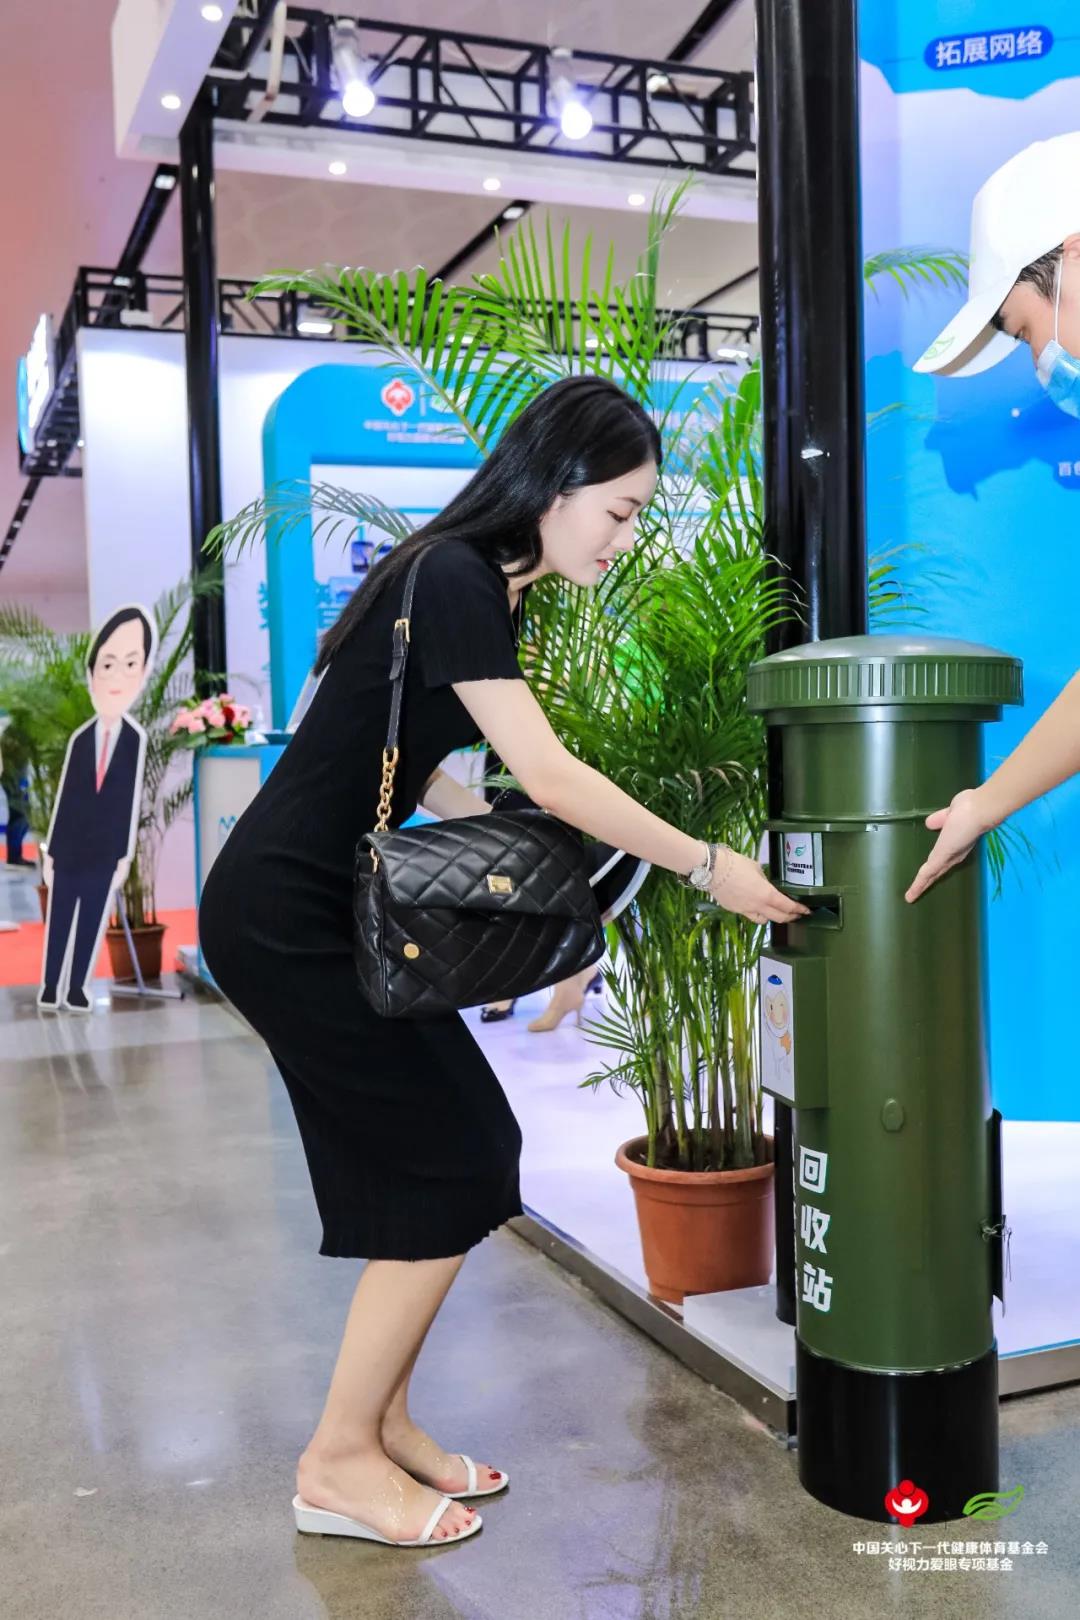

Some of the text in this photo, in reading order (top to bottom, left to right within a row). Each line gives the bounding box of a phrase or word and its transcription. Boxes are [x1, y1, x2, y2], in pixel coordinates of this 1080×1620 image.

[935, 29, 1043, 68] 拓展网络
[799, 1145, 834, 1313] 回收站
